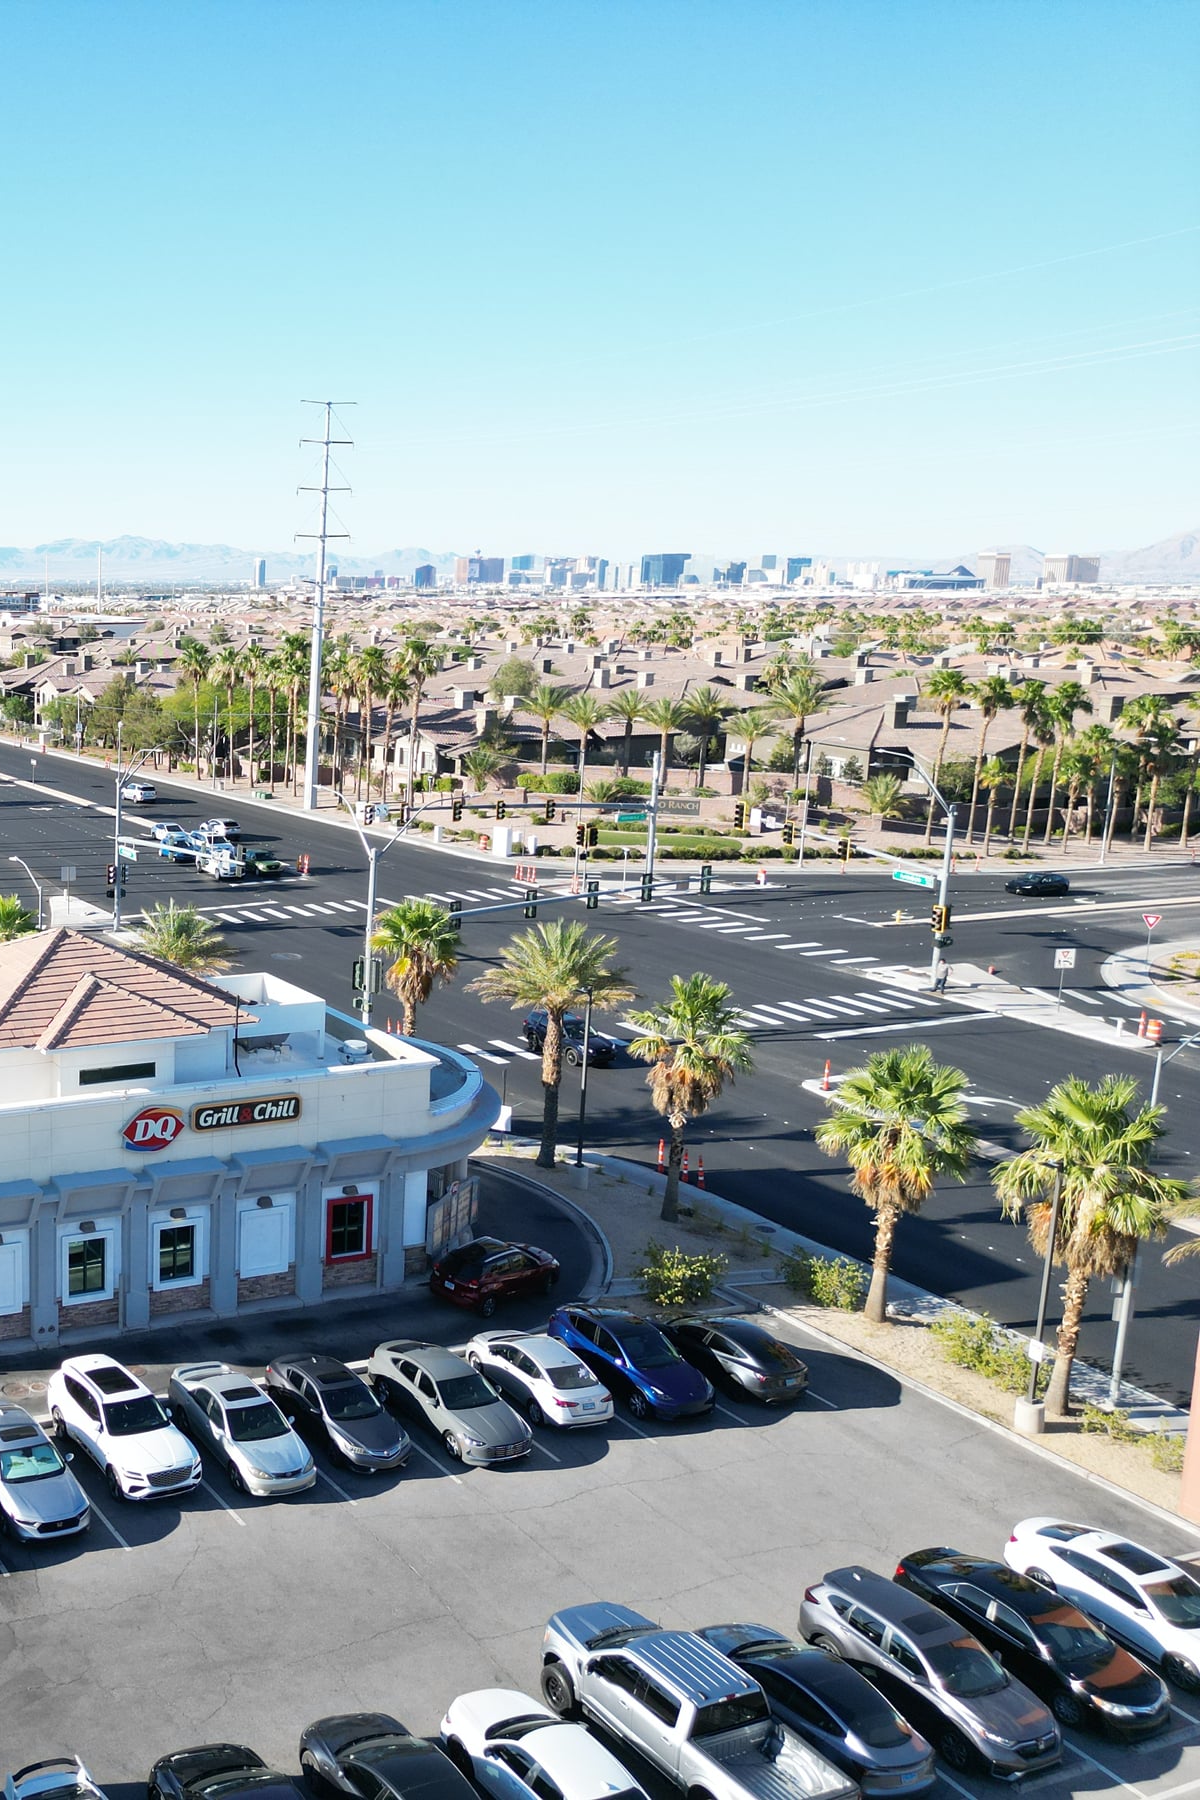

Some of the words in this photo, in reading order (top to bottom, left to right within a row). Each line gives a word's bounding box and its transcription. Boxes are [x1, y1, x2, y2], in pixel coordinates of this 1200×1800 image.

[669, 800, 699, 810] RANCH
[199, 1106, 239, 1127] Grill
[240, 1107, 252, 1122] &
[253, 1099, 296, 1120] Chill
[133, 1116, 176, 1142] DQ
